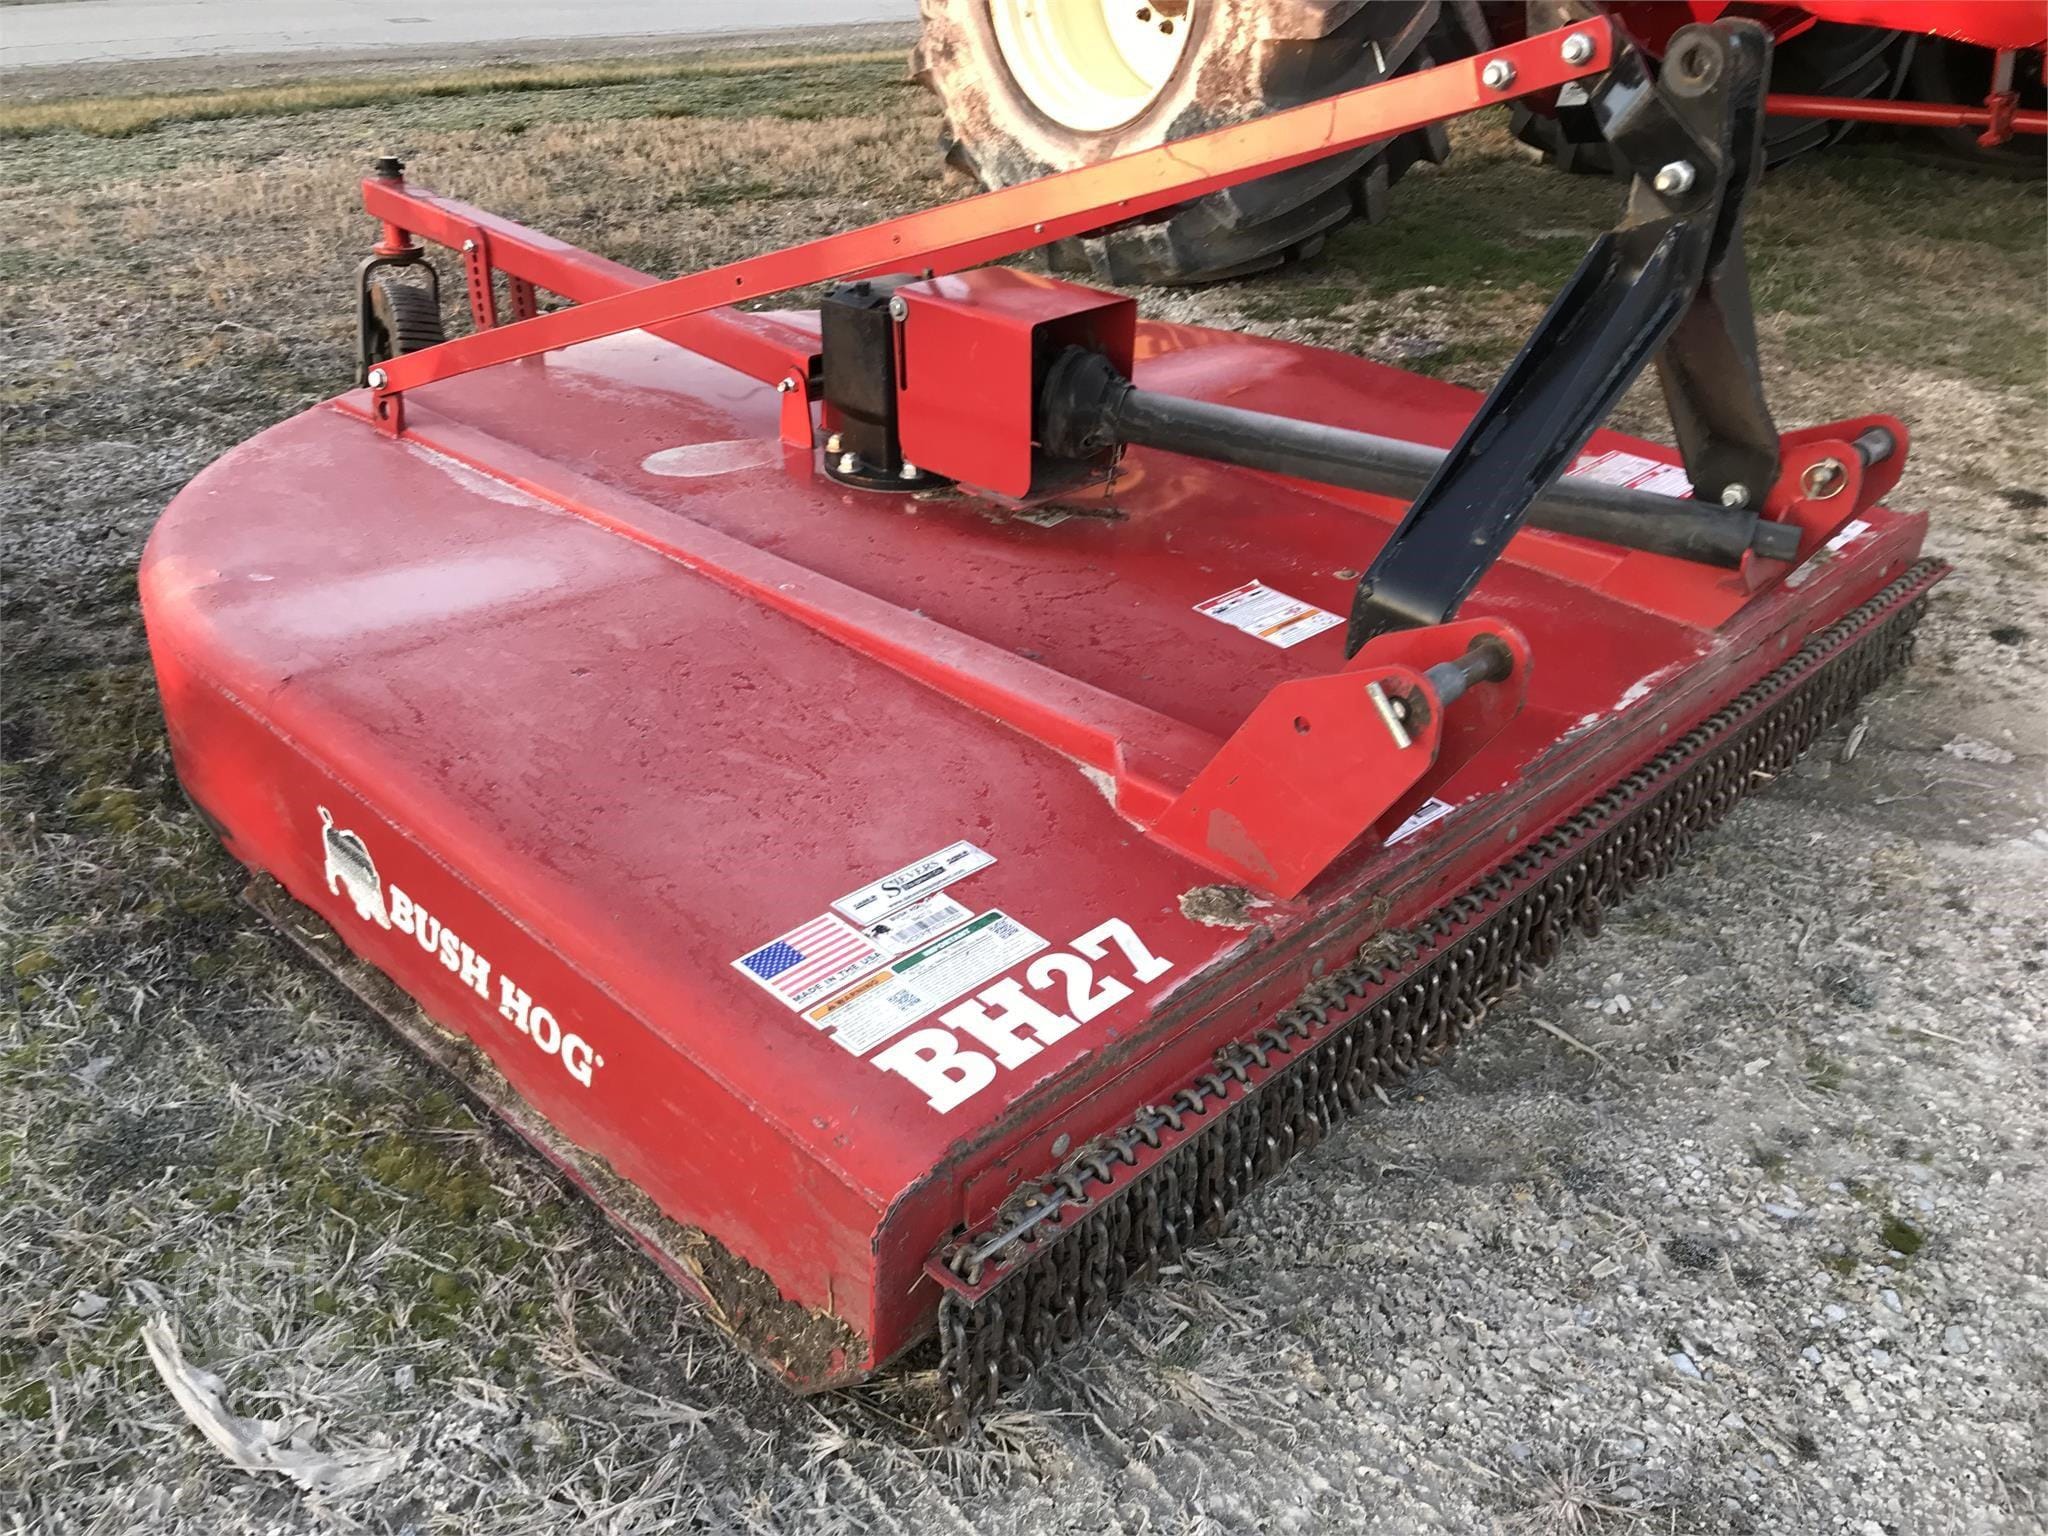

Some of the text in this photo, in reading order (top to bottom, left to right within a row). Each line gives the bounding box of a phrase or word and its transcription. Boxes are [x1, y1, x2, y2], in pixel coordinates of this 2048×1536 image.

[881, 860, 940, 898] SIEVERS
[389, 883, 594, 1088] BUSH HOG
[792, 952, 881, 1002] MADE IN THE USA
[870, 917, 1175, 1115] BH27
